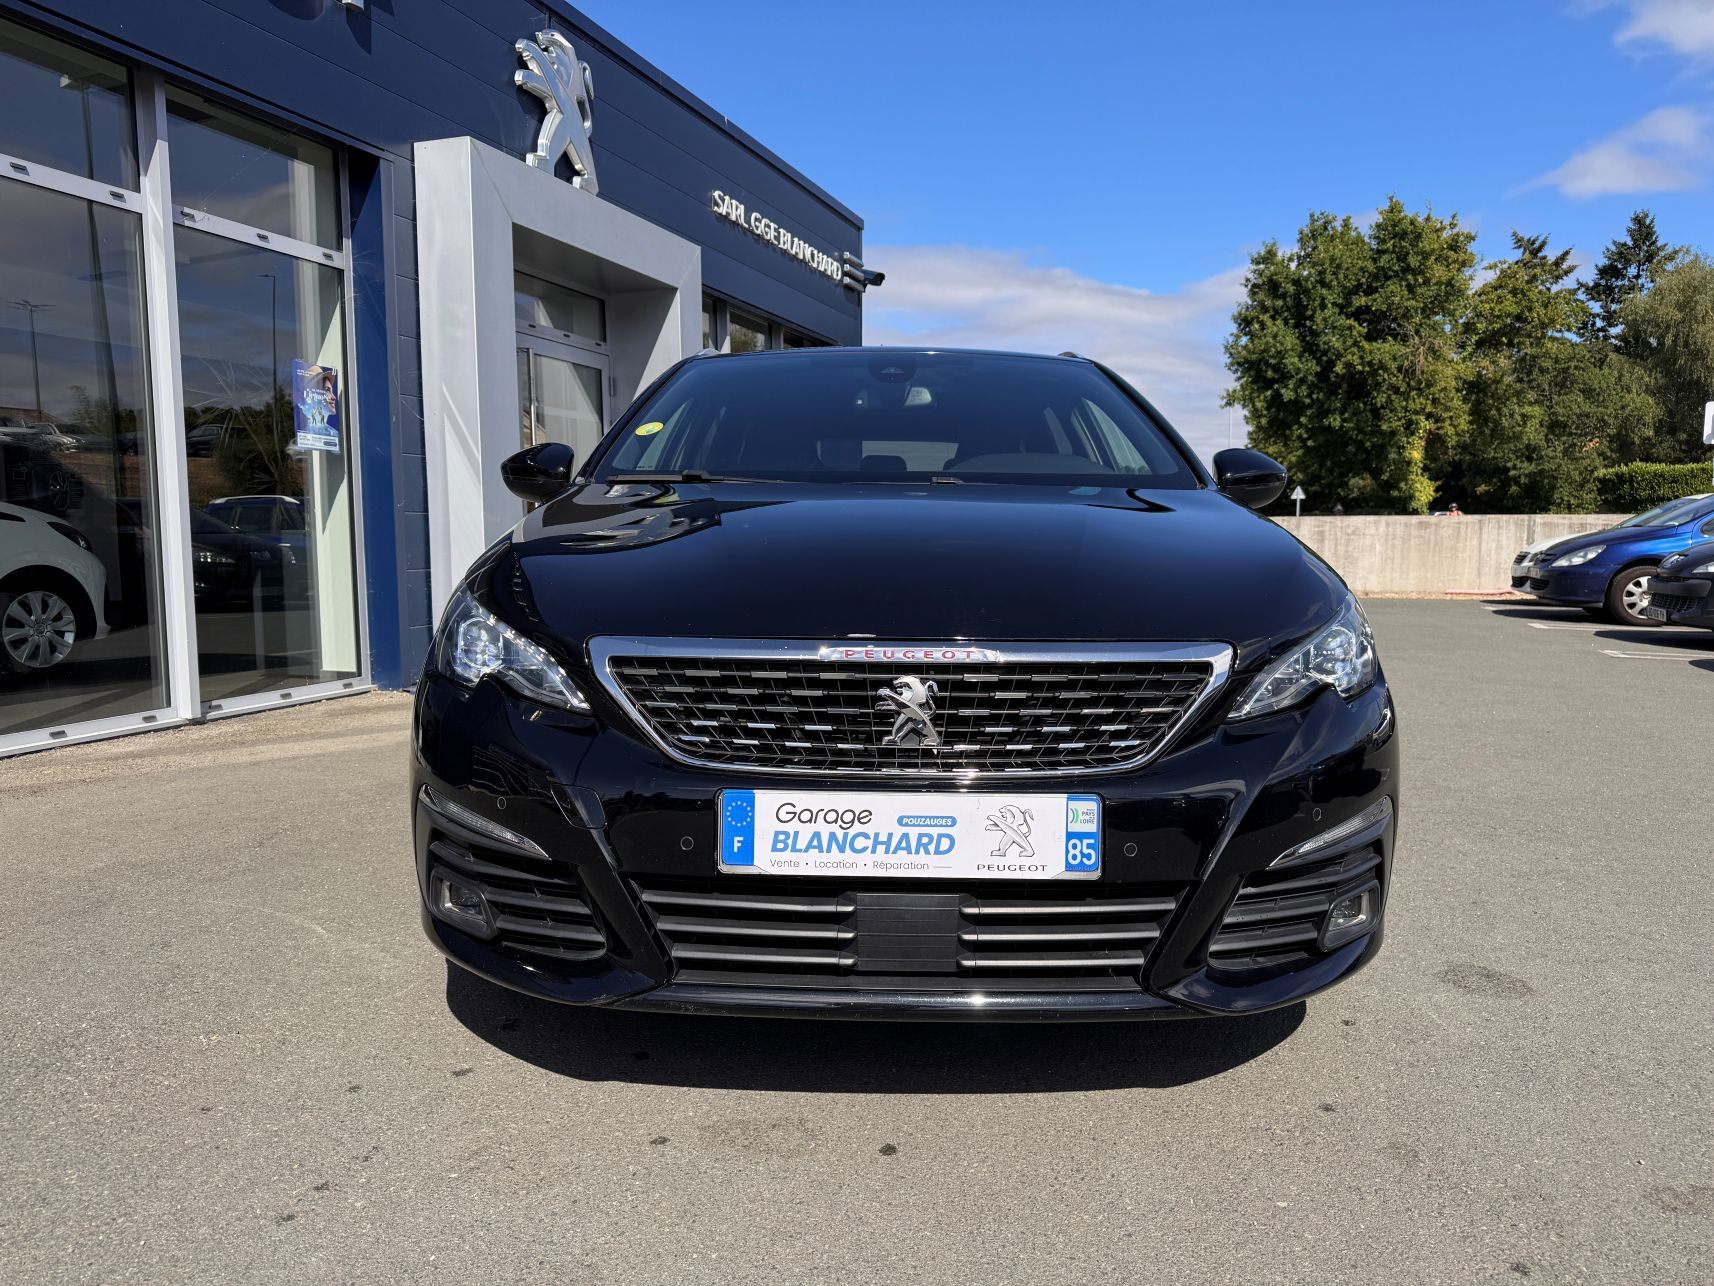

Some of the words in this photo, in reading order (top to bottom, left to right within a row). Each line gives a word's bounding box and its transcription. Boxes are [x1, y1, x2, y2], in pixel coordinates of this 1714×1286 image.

[712, 190, 749, 229] SARL
[750, 212, 778, 245] GGE
[778, 228, 842, 281] BLANCHARD
[843, 649, 975, 660] PEUGEOT
[775, 802, 873, 830] Garage
[902, 817, 953, 826] POUZAUGES
[733, 836, 744, 853] F
[771, 830, 956, 856] BLANCHARD
[1067, 838, 1096, 865] 85
[770, 858, 800, 868] Vente
[814, 860, 858, 869] Location
[873, 860, 929, 872] Réparation
[977, 864, 1048, 872] PEUGEOT
